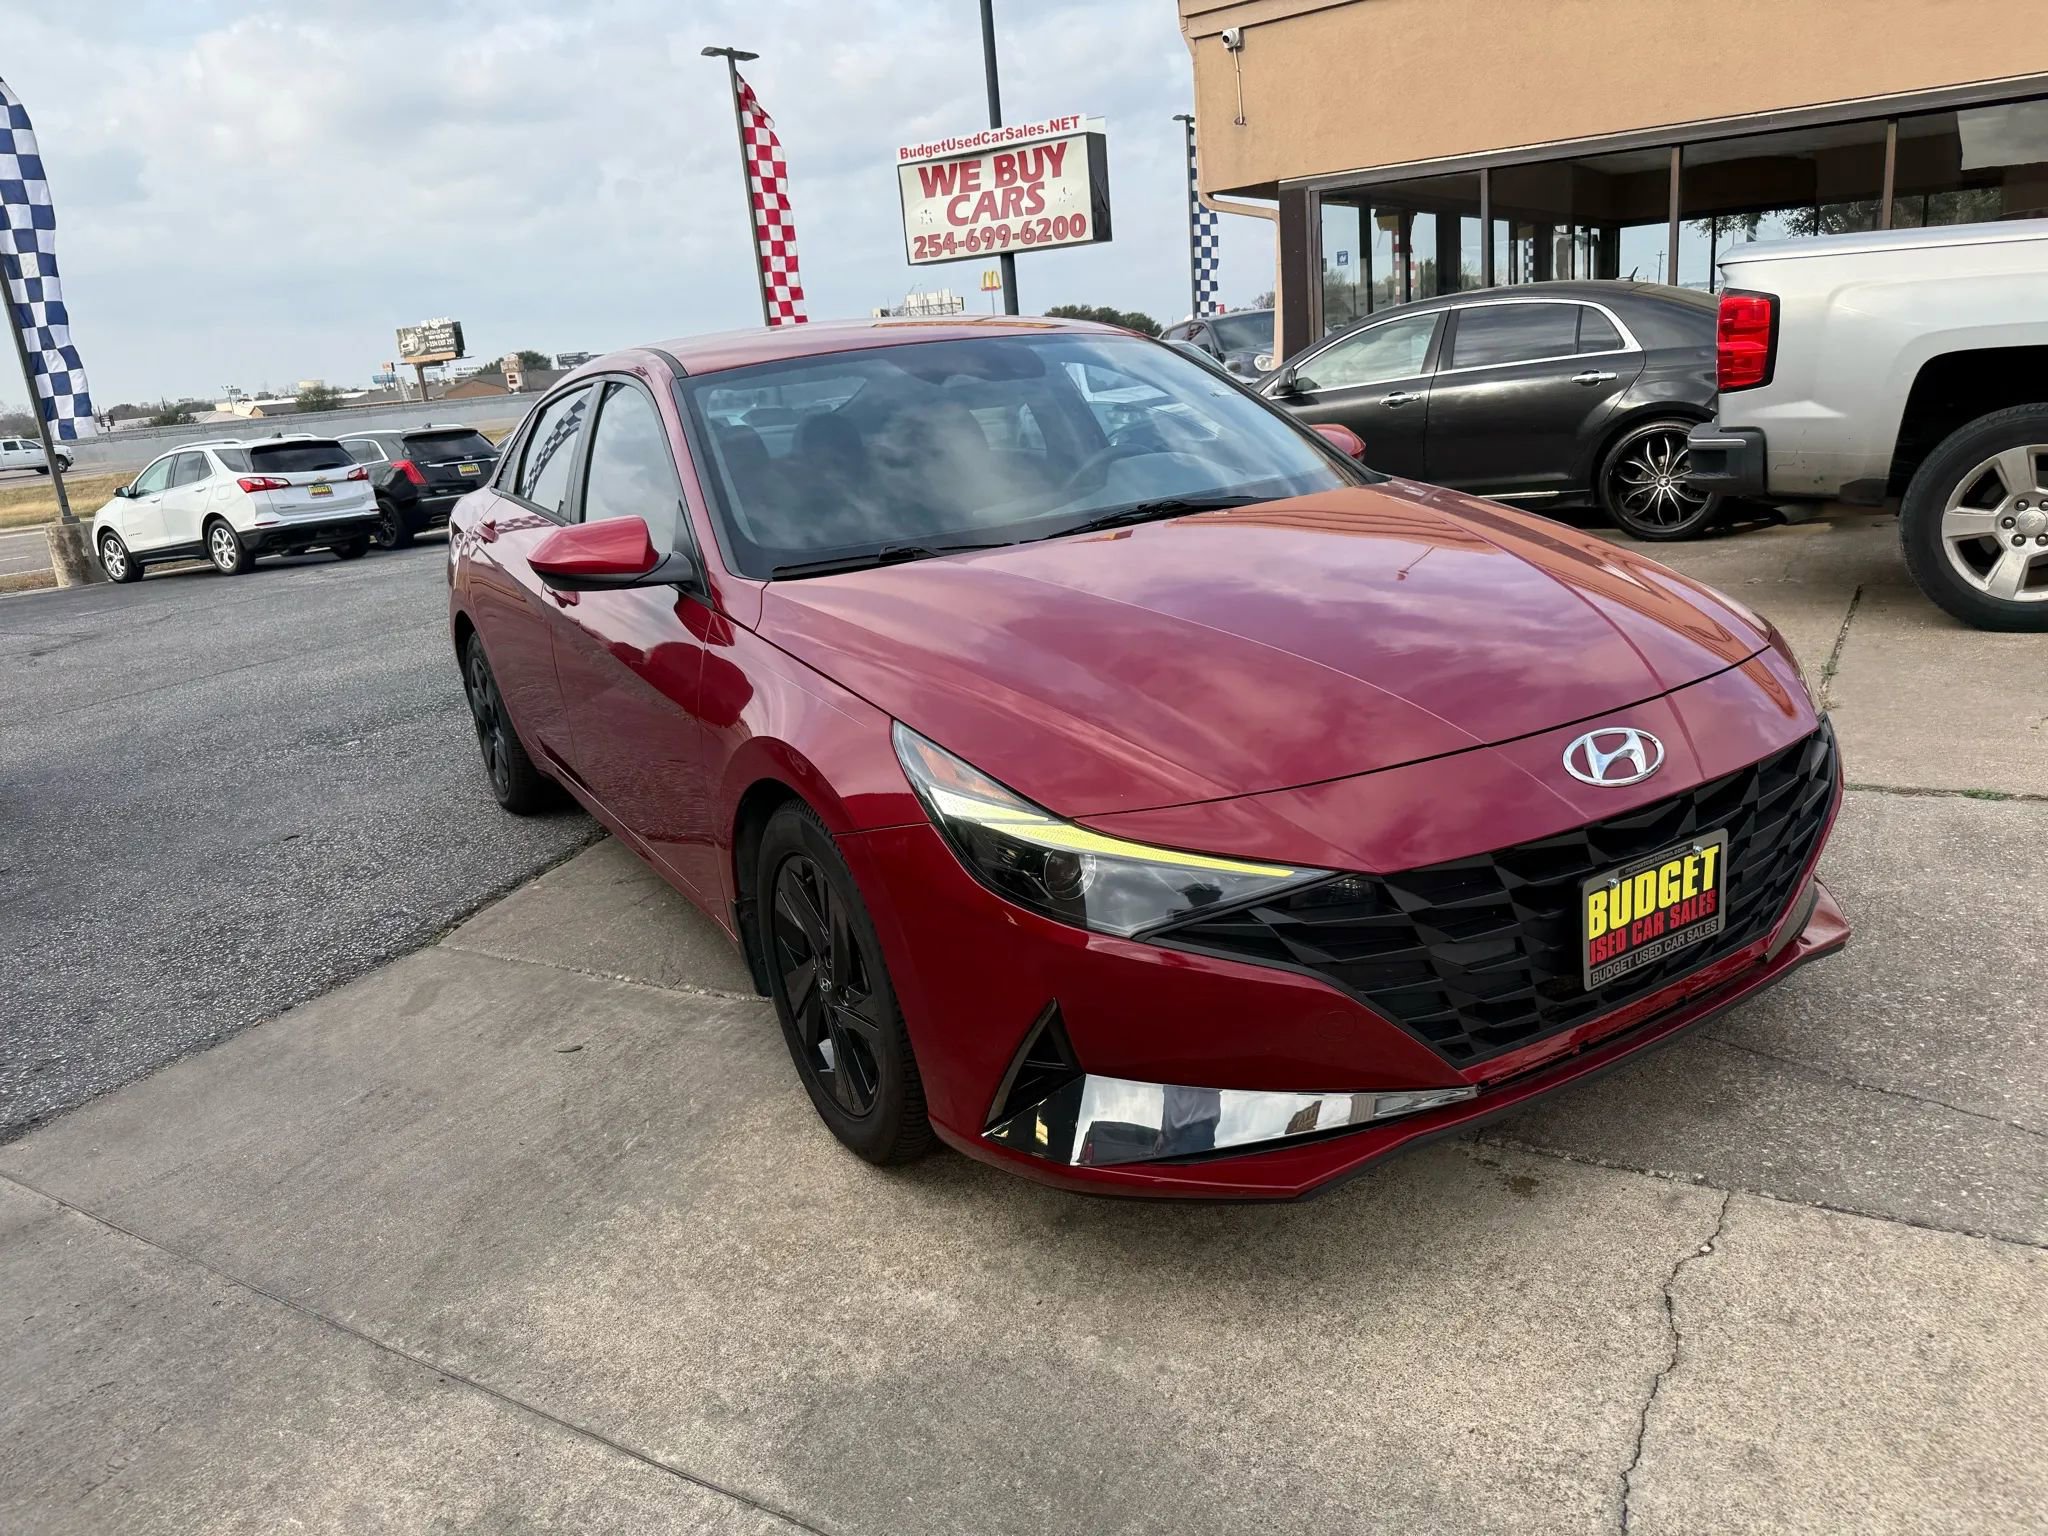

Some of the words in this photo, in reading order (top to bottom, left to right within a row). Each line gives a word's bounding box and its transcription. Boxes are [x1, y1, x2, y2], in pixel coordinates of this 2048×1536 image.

[900, 115, 1080, 160] BudgetUsedCarSales.NET
[917, 160, 982, 198] WE
[993, 141, 1068, 189] BUY
[946, 182, 1045, 227] CARS
[913, 213, 1087, 260] 254-699-6200
[1588, 845, 1720, 940] BUDGET
[1632, 911, 1665, 946] CAR
[1669, 889, 1717, 929] SALES
[1592, 957, 1634, 985] BUDGET
[1635, 944, 1662, 964] USED
[1664, 934, 1685, 952] CAR
[1686, 920, 1717, 942] SALES
